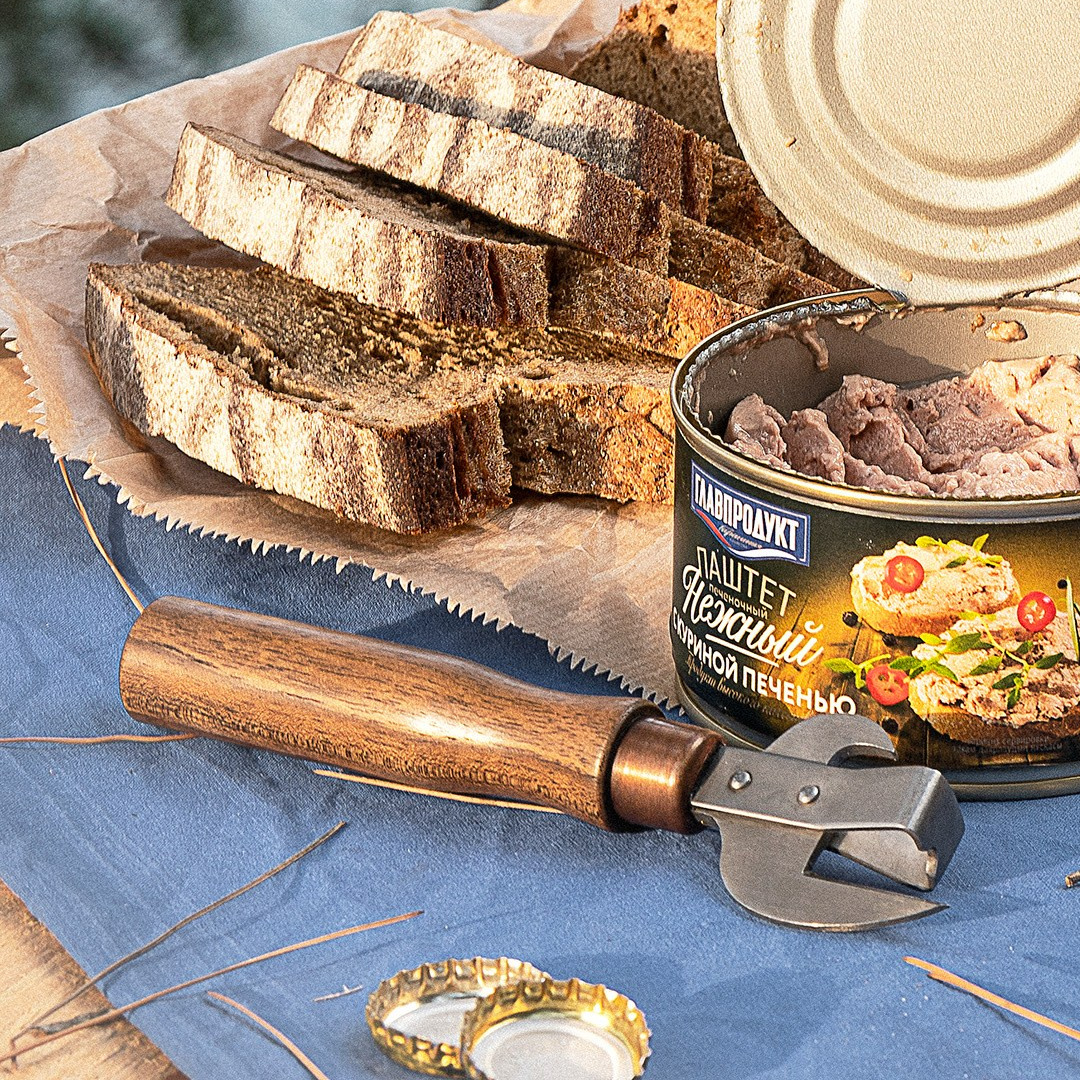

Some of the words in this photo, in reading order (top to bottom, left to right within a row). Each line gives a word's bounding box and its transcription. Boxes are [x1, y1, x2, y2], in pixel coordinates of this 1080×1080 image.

[694, 472, 799, 551] ГЛАВПРОДУКТ
[682, 565, 824, 667] Нежный
[696, 546, 797, 617] ПАШТЕТ
[708, 584, 768, 621] печеночный
[677, 617, 739, 684] КУРИНОЙ
[743, 665, 857, 714] ПЕЧЕНЬЮ
